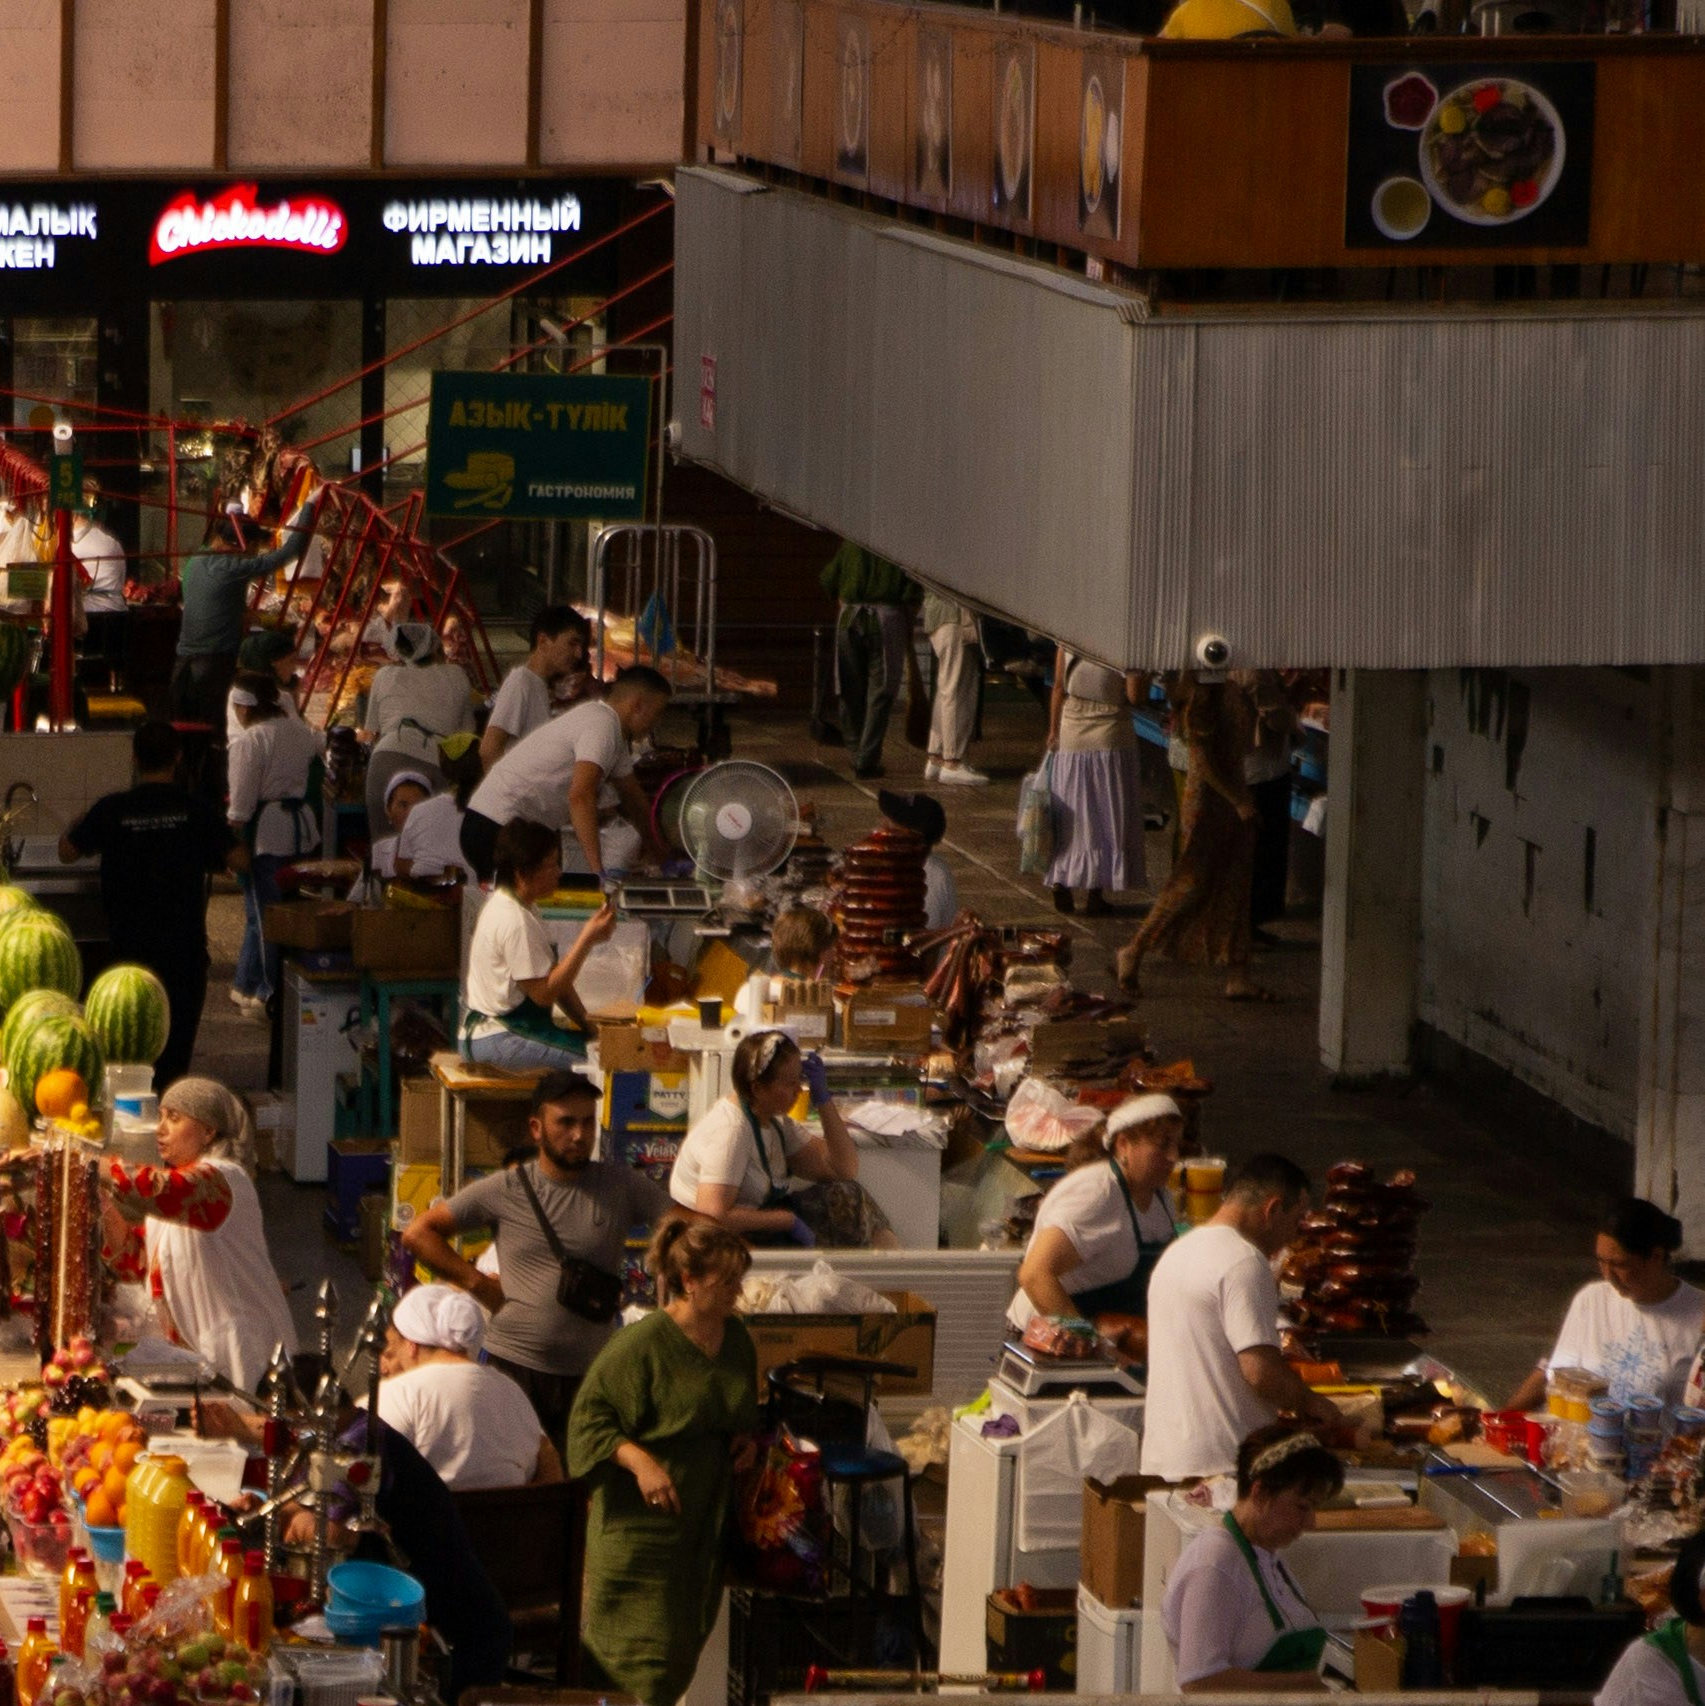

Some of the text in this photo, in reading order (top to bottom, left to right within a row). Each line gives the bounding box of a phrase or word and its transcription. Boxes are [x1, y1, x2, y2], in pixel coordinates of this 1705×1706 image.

[383, 194, 580, 231] ФИРМЕННЫЙ
[411, 233, 551, 264] МАГАЗИН
[527, 483, 636, 501] ГАСТРОНОМИЯ
